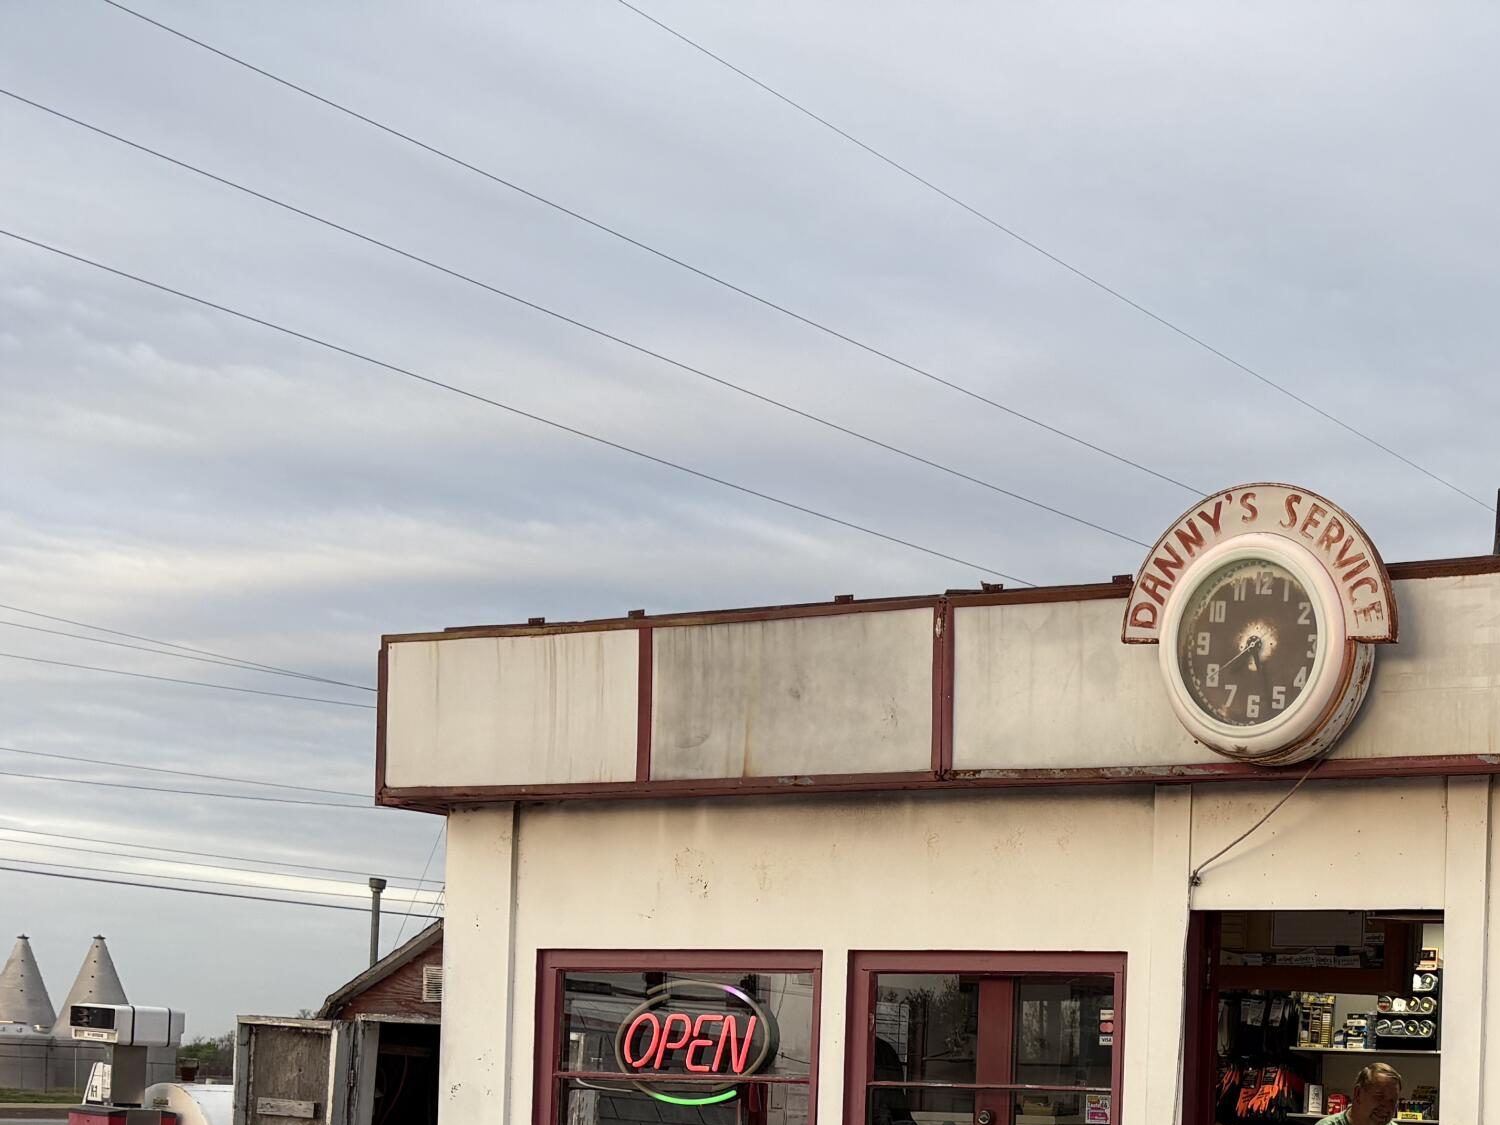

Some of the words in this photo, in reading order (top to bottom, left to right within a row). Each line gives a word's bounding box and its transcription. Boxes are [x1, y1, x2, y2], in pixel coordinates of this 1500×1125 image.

[1129, 492, 1259, 629] DANNY'S
[1279, 494, 1384, 627] SERVICE
[1255, 571, 1273, 595] 12
[1209, 600, 1226, 623] 10
[1297, 602, 1312, 625] 2
[1196, 632, 1211, 655] 9
[1206, 664, 1220, 687] 8
[1224, 684, 1239, 708] 7
[1272, 686, 1287, 710] 5
[1246, 695, 1260, 718] 6
[623, 1011, 757, 1073] OPEN
